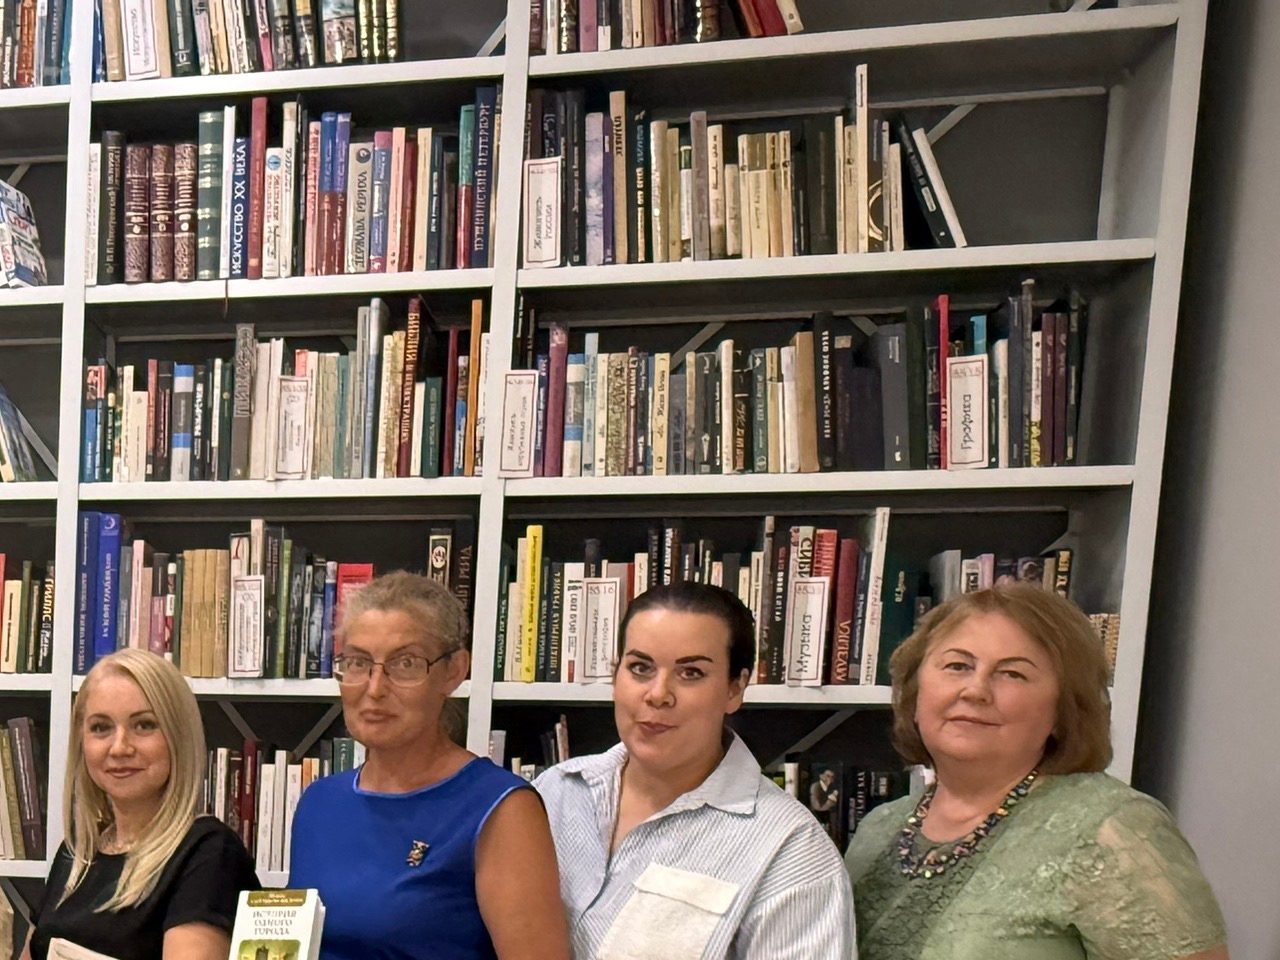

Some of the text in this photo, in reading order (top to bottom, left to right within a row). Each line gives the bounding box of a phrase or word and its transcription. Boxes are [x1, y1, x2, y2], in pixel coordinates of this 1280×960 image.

[235, 145, 247, 175] ВЕКА
[477, 103, 490, 166] ПЕТЕРБУРГ
[355, 171, 367, 213] РЕРИХА
[232, 204, 244, 274] ИСКУССТВО
[405, 312, 420, 361] БИБЛИЯ
[960, 394, 973, 450] Графика
[796, 613, 812, 674] Музыка
[837, 620, 851, 681] МУЗЫКА
